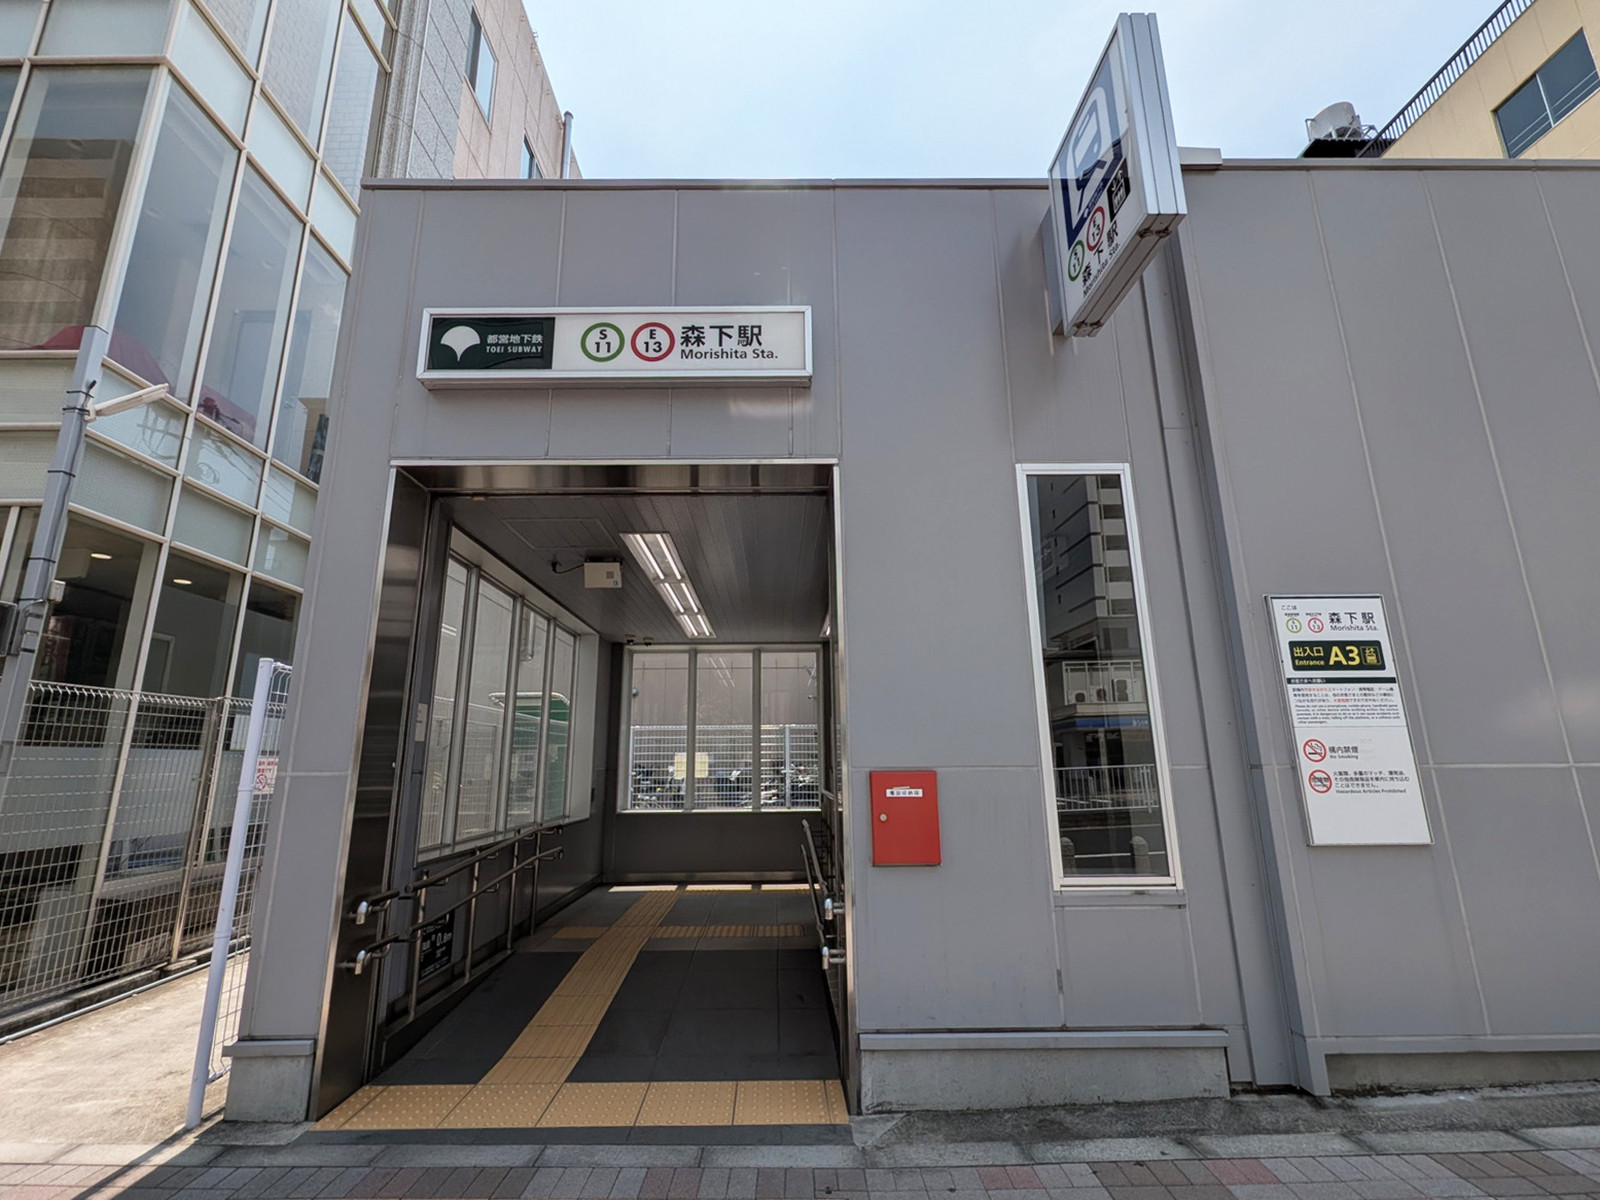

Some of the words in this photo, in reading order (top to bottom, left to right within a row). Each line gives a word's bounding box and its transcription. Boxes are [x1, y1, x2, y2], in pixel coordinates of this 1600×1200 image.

[487, 334, 543, 344] 都営地下鉄
[599, 329, 608, 340] S
[649, 329, 657, 339] E
[680, 325, 763, 347] 森下駅
[594, 342, 612, 353] 11
[643, 341, 663, 353] 13
[680, 348, 748, 360] Morishita
[752, 348, 779, 360] Sta.
[1328, 612, 1376, 625] 森下駅
[1293, 646, 1324, 657] 出入口
[1329, 645, 1361, 666] A3
[1328, 745, 1359, 754] 構内禁煙
